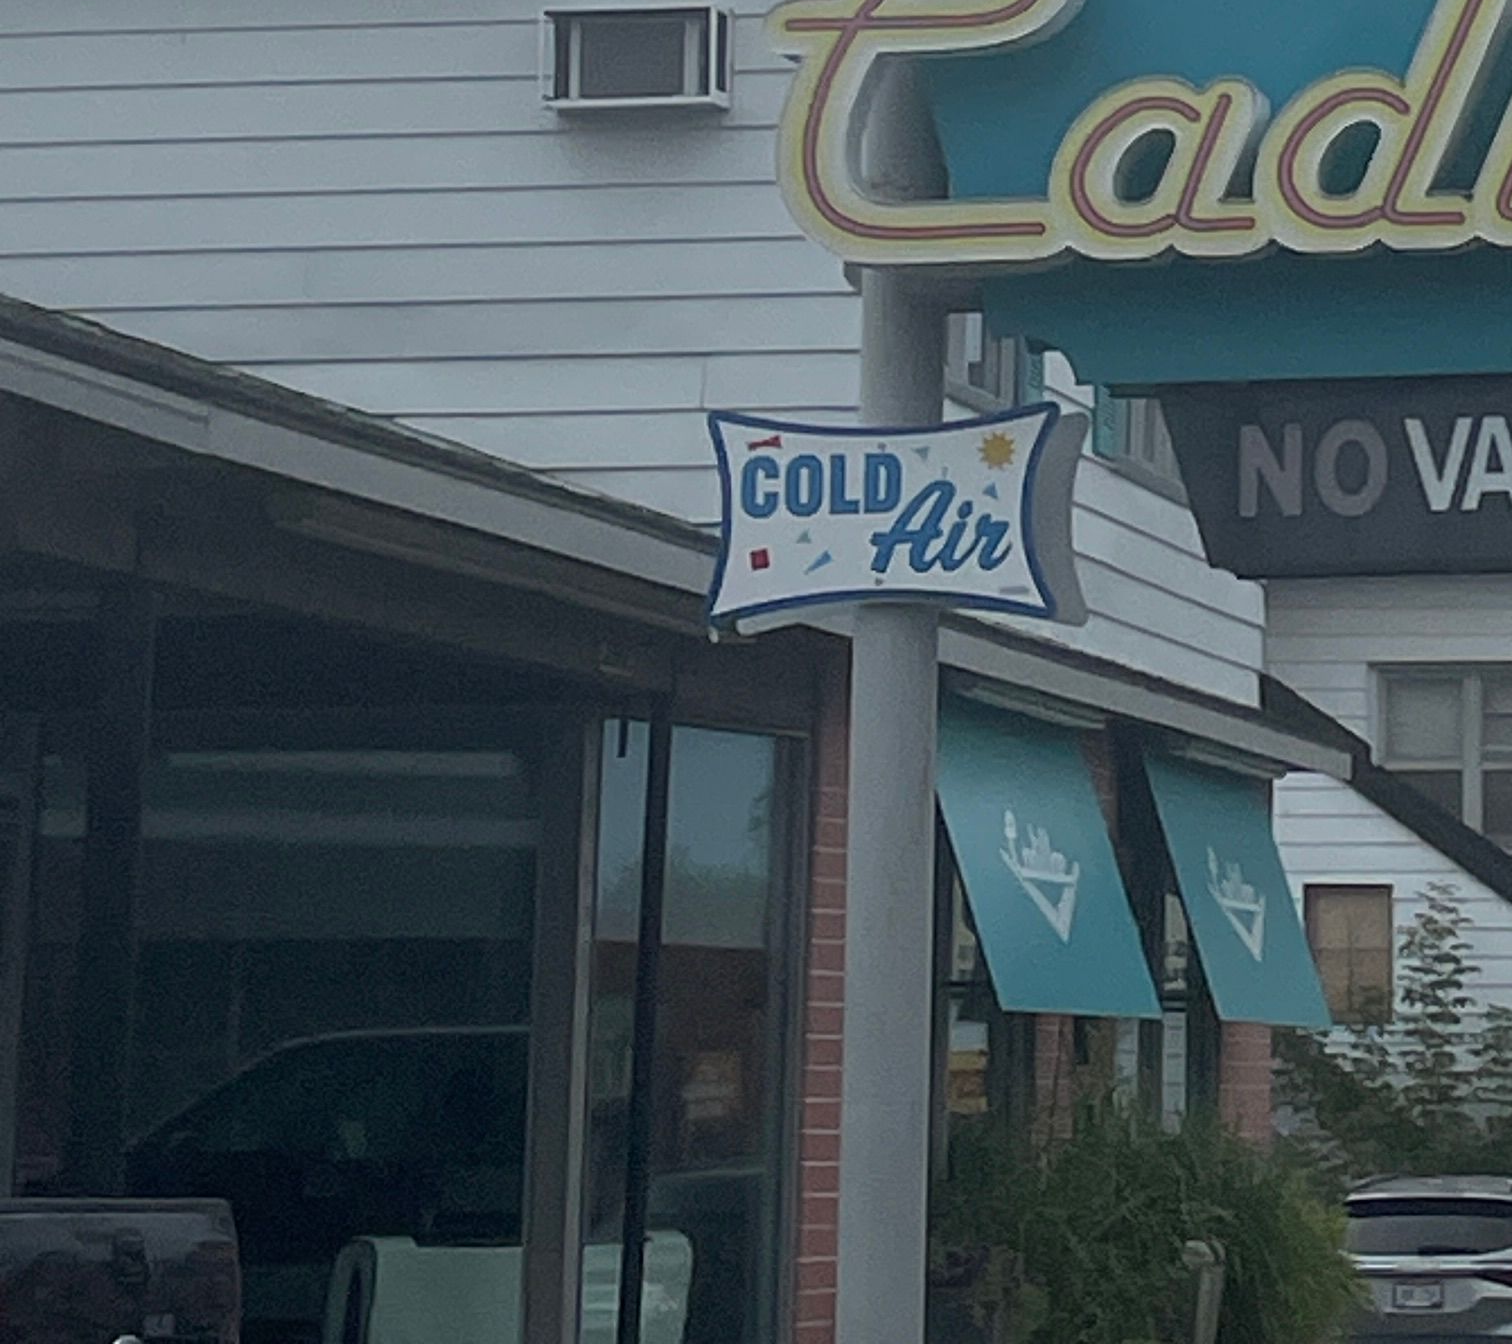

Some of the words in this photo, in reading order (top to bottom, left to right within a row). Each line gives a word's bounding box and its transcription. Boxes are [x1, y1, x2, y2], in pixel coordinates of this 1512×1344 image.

[740, 452, 902, 518] COLD
[1238, 418, 1388, 518] NO
[870, 480, 1012, 573] Air
